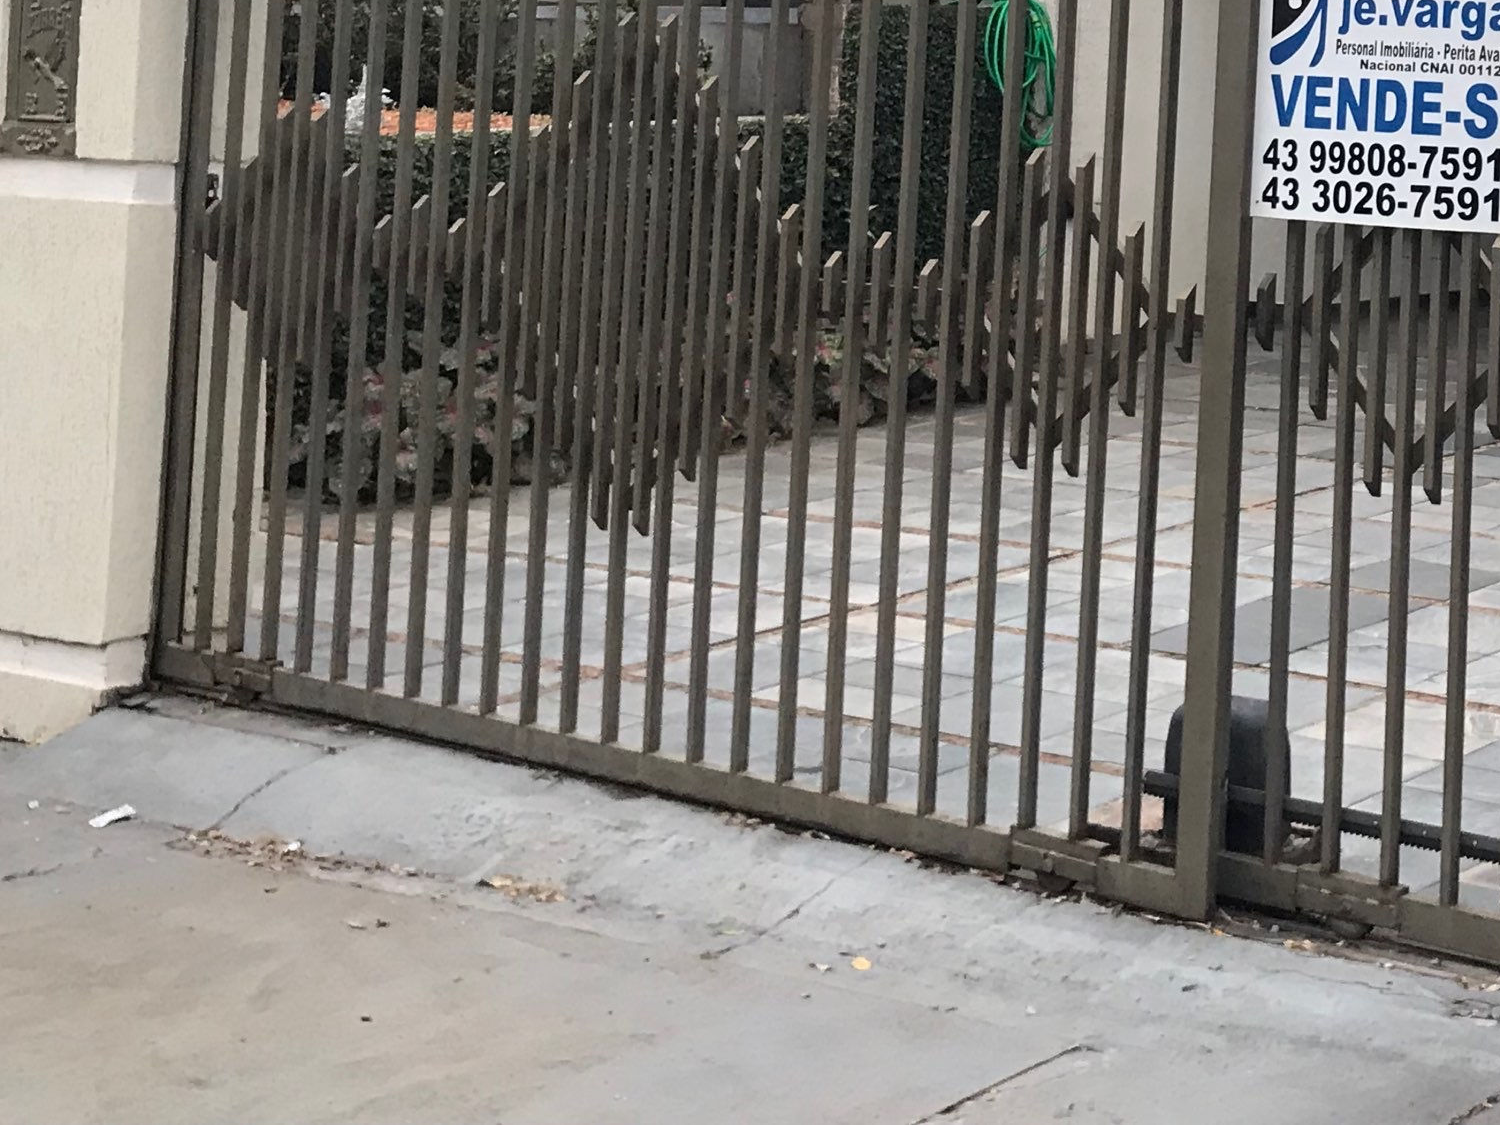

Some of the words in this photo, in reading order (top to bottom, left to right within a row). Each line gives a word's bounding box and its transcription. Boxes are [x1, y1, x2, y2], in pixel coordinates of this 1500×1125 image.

[1335, 38, 1378, 57] Personal
[1380, 40, 1435, 60] Imobiliária
[1443, 43, 1476, 62] Perita
[1360, 59, 1416, 73] Nacional
[1420, 62, 1454, 74] CNAI
[1262, 138, 1298, 172] 43
[1261, 176, 1300, 211] 43
[1312, 179, 1500, 222] 3026-7591
